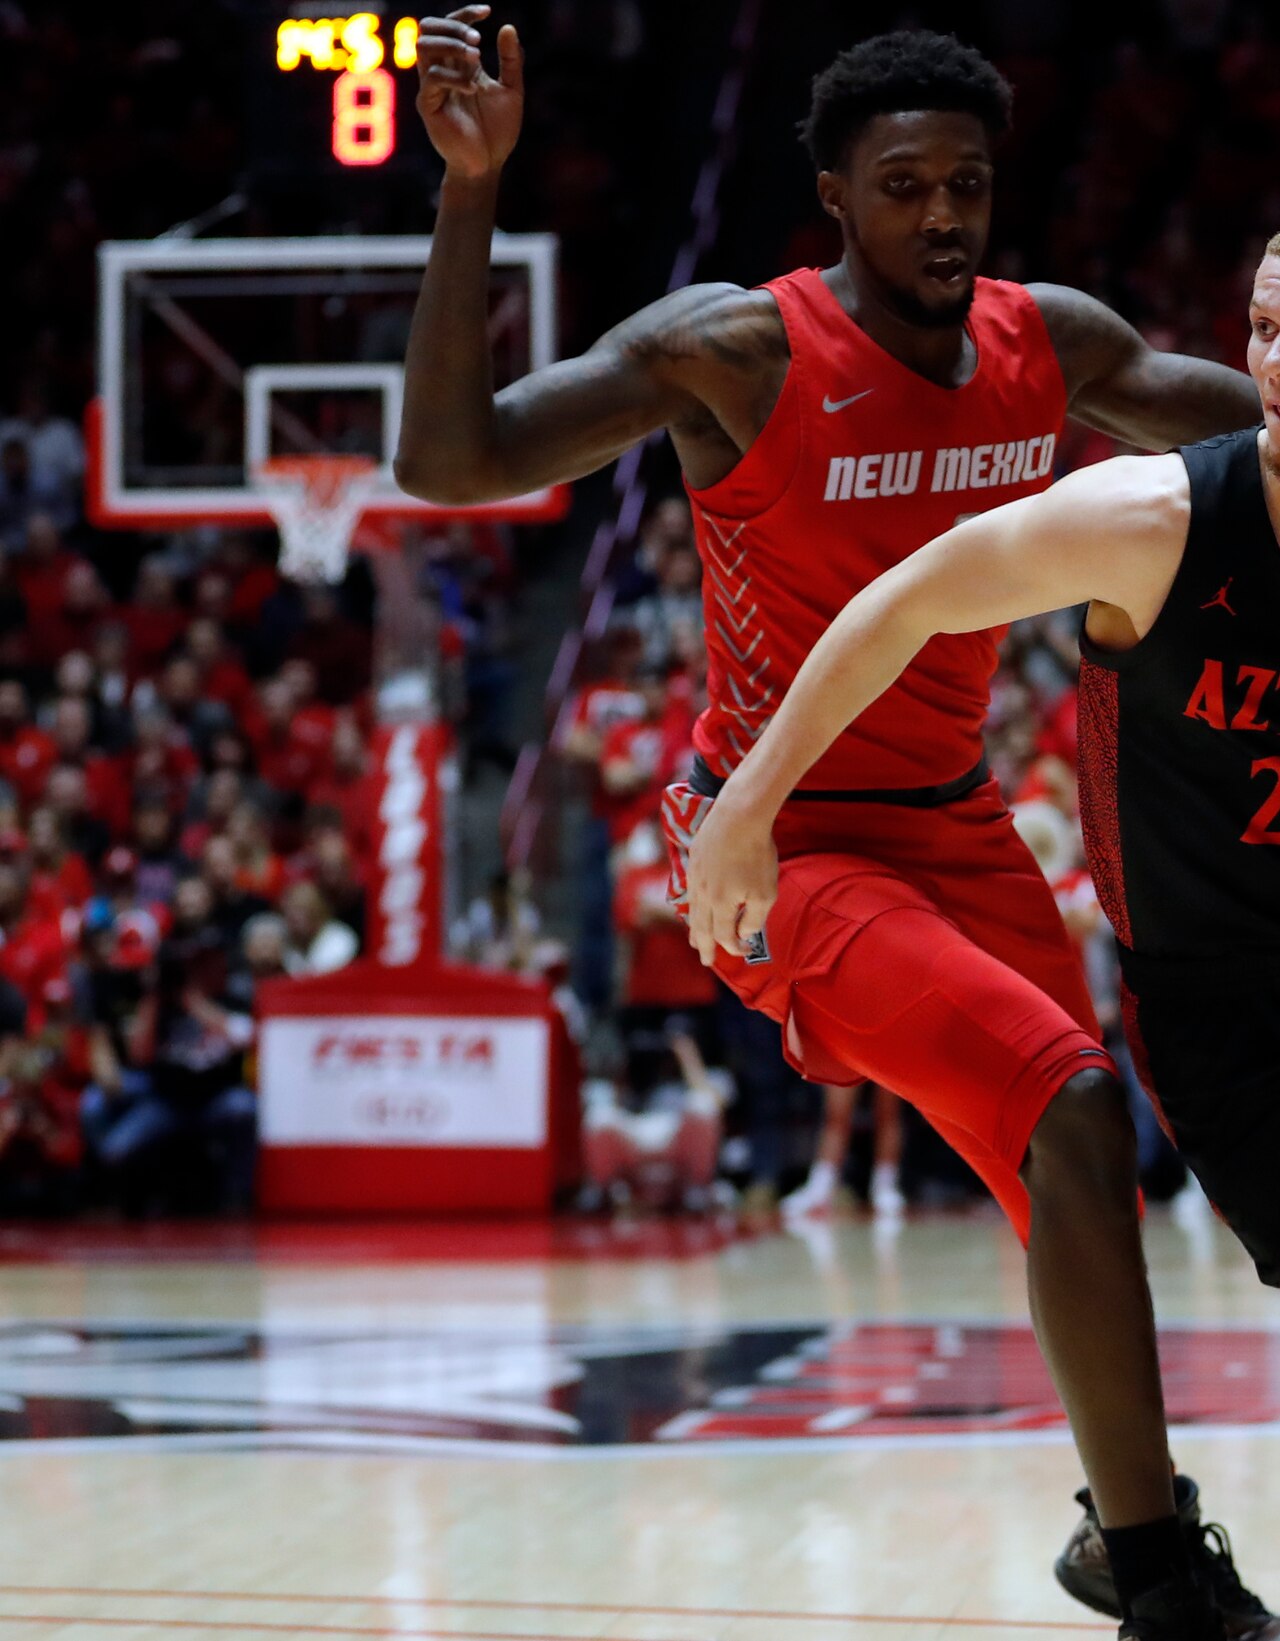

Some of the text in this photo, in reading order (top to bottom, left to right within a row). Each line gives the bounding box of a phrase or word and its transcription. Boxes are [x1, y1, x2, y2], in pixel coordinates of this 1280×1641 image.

[332, 67, 396, 167] 8
[823, 433, 1056, 502] NEW MEXICO
